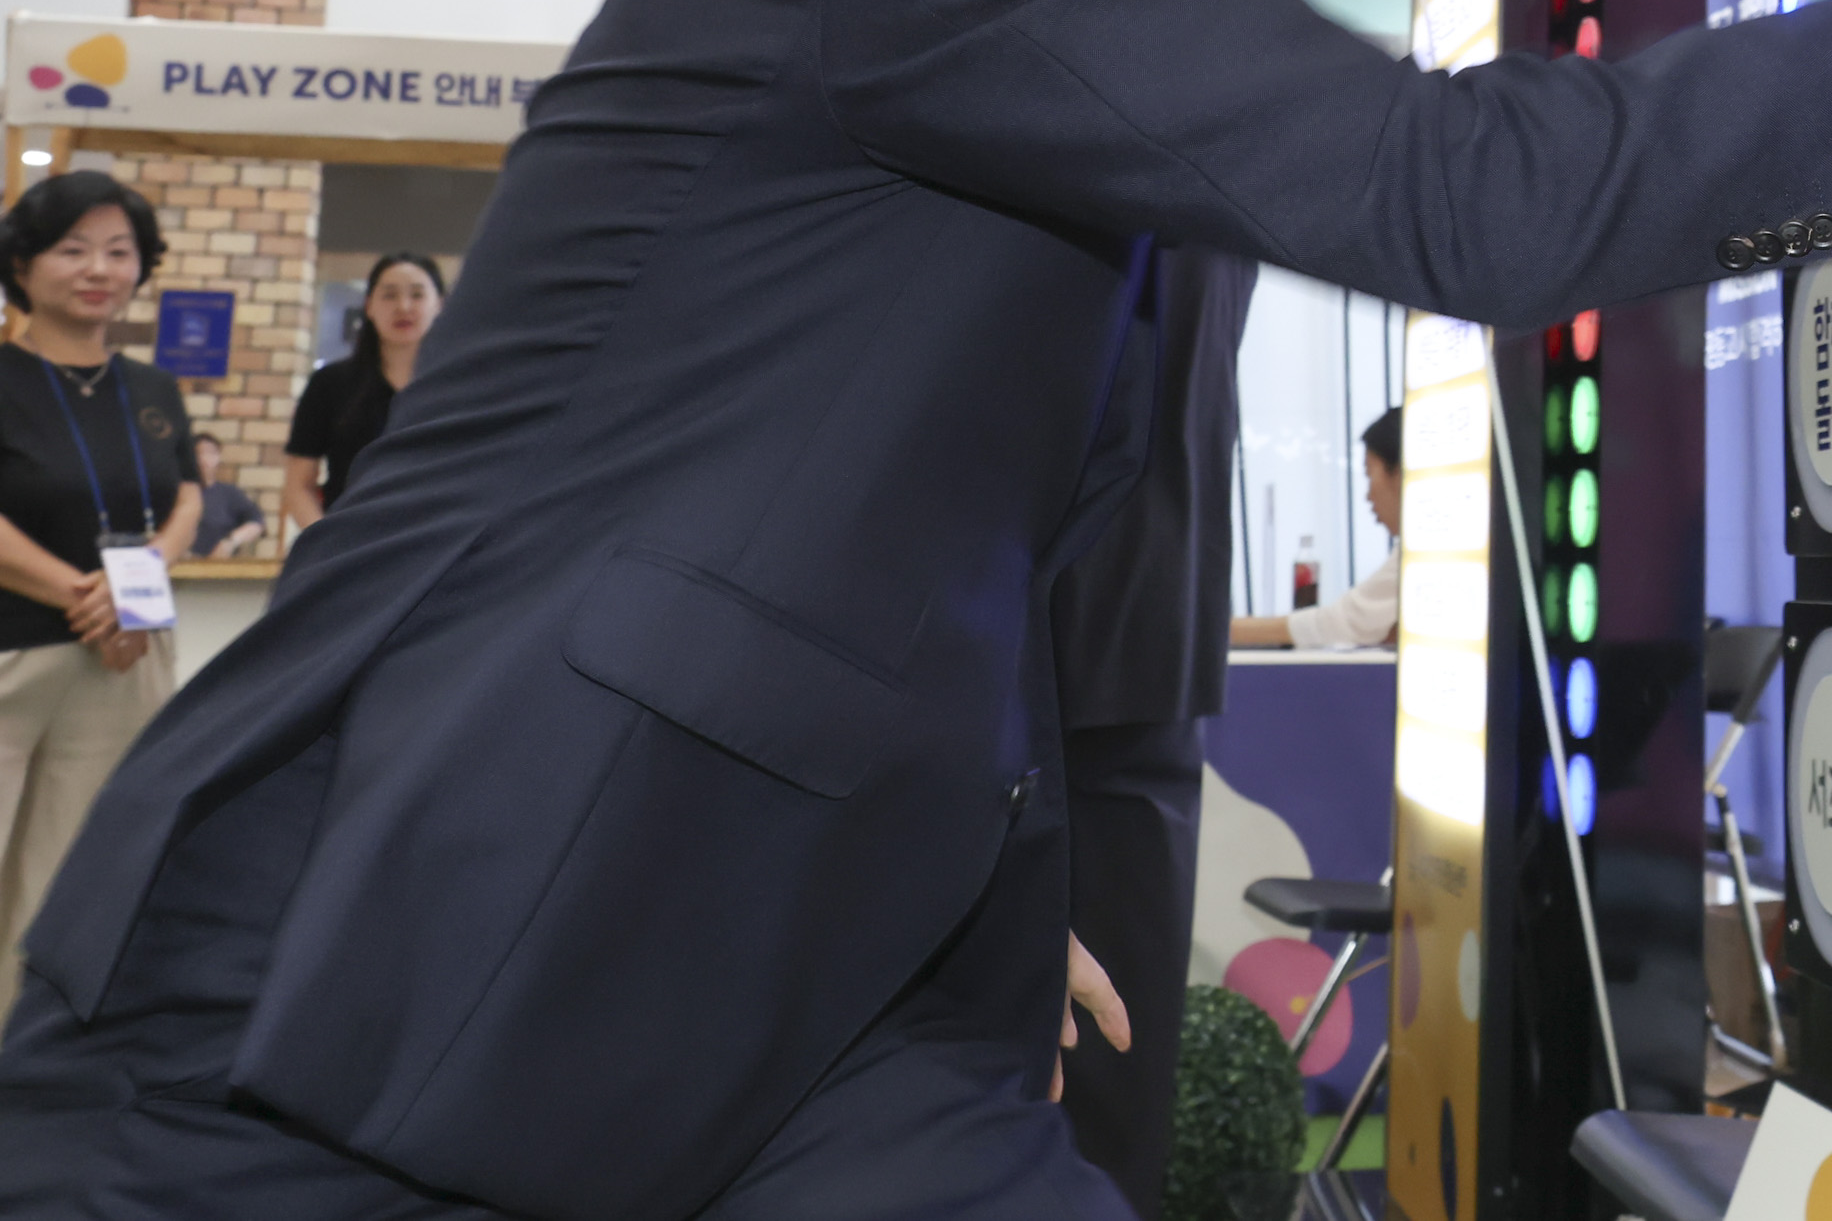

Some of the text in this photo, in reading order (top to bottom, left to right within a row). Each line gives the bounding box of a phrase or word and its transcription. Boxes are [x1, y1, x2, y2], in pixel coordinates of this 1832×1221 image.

[162, 61, 278, 97] PLAY
[292, 67, 421, 103] ZONE
[434, 72, 502, 108] 안내
